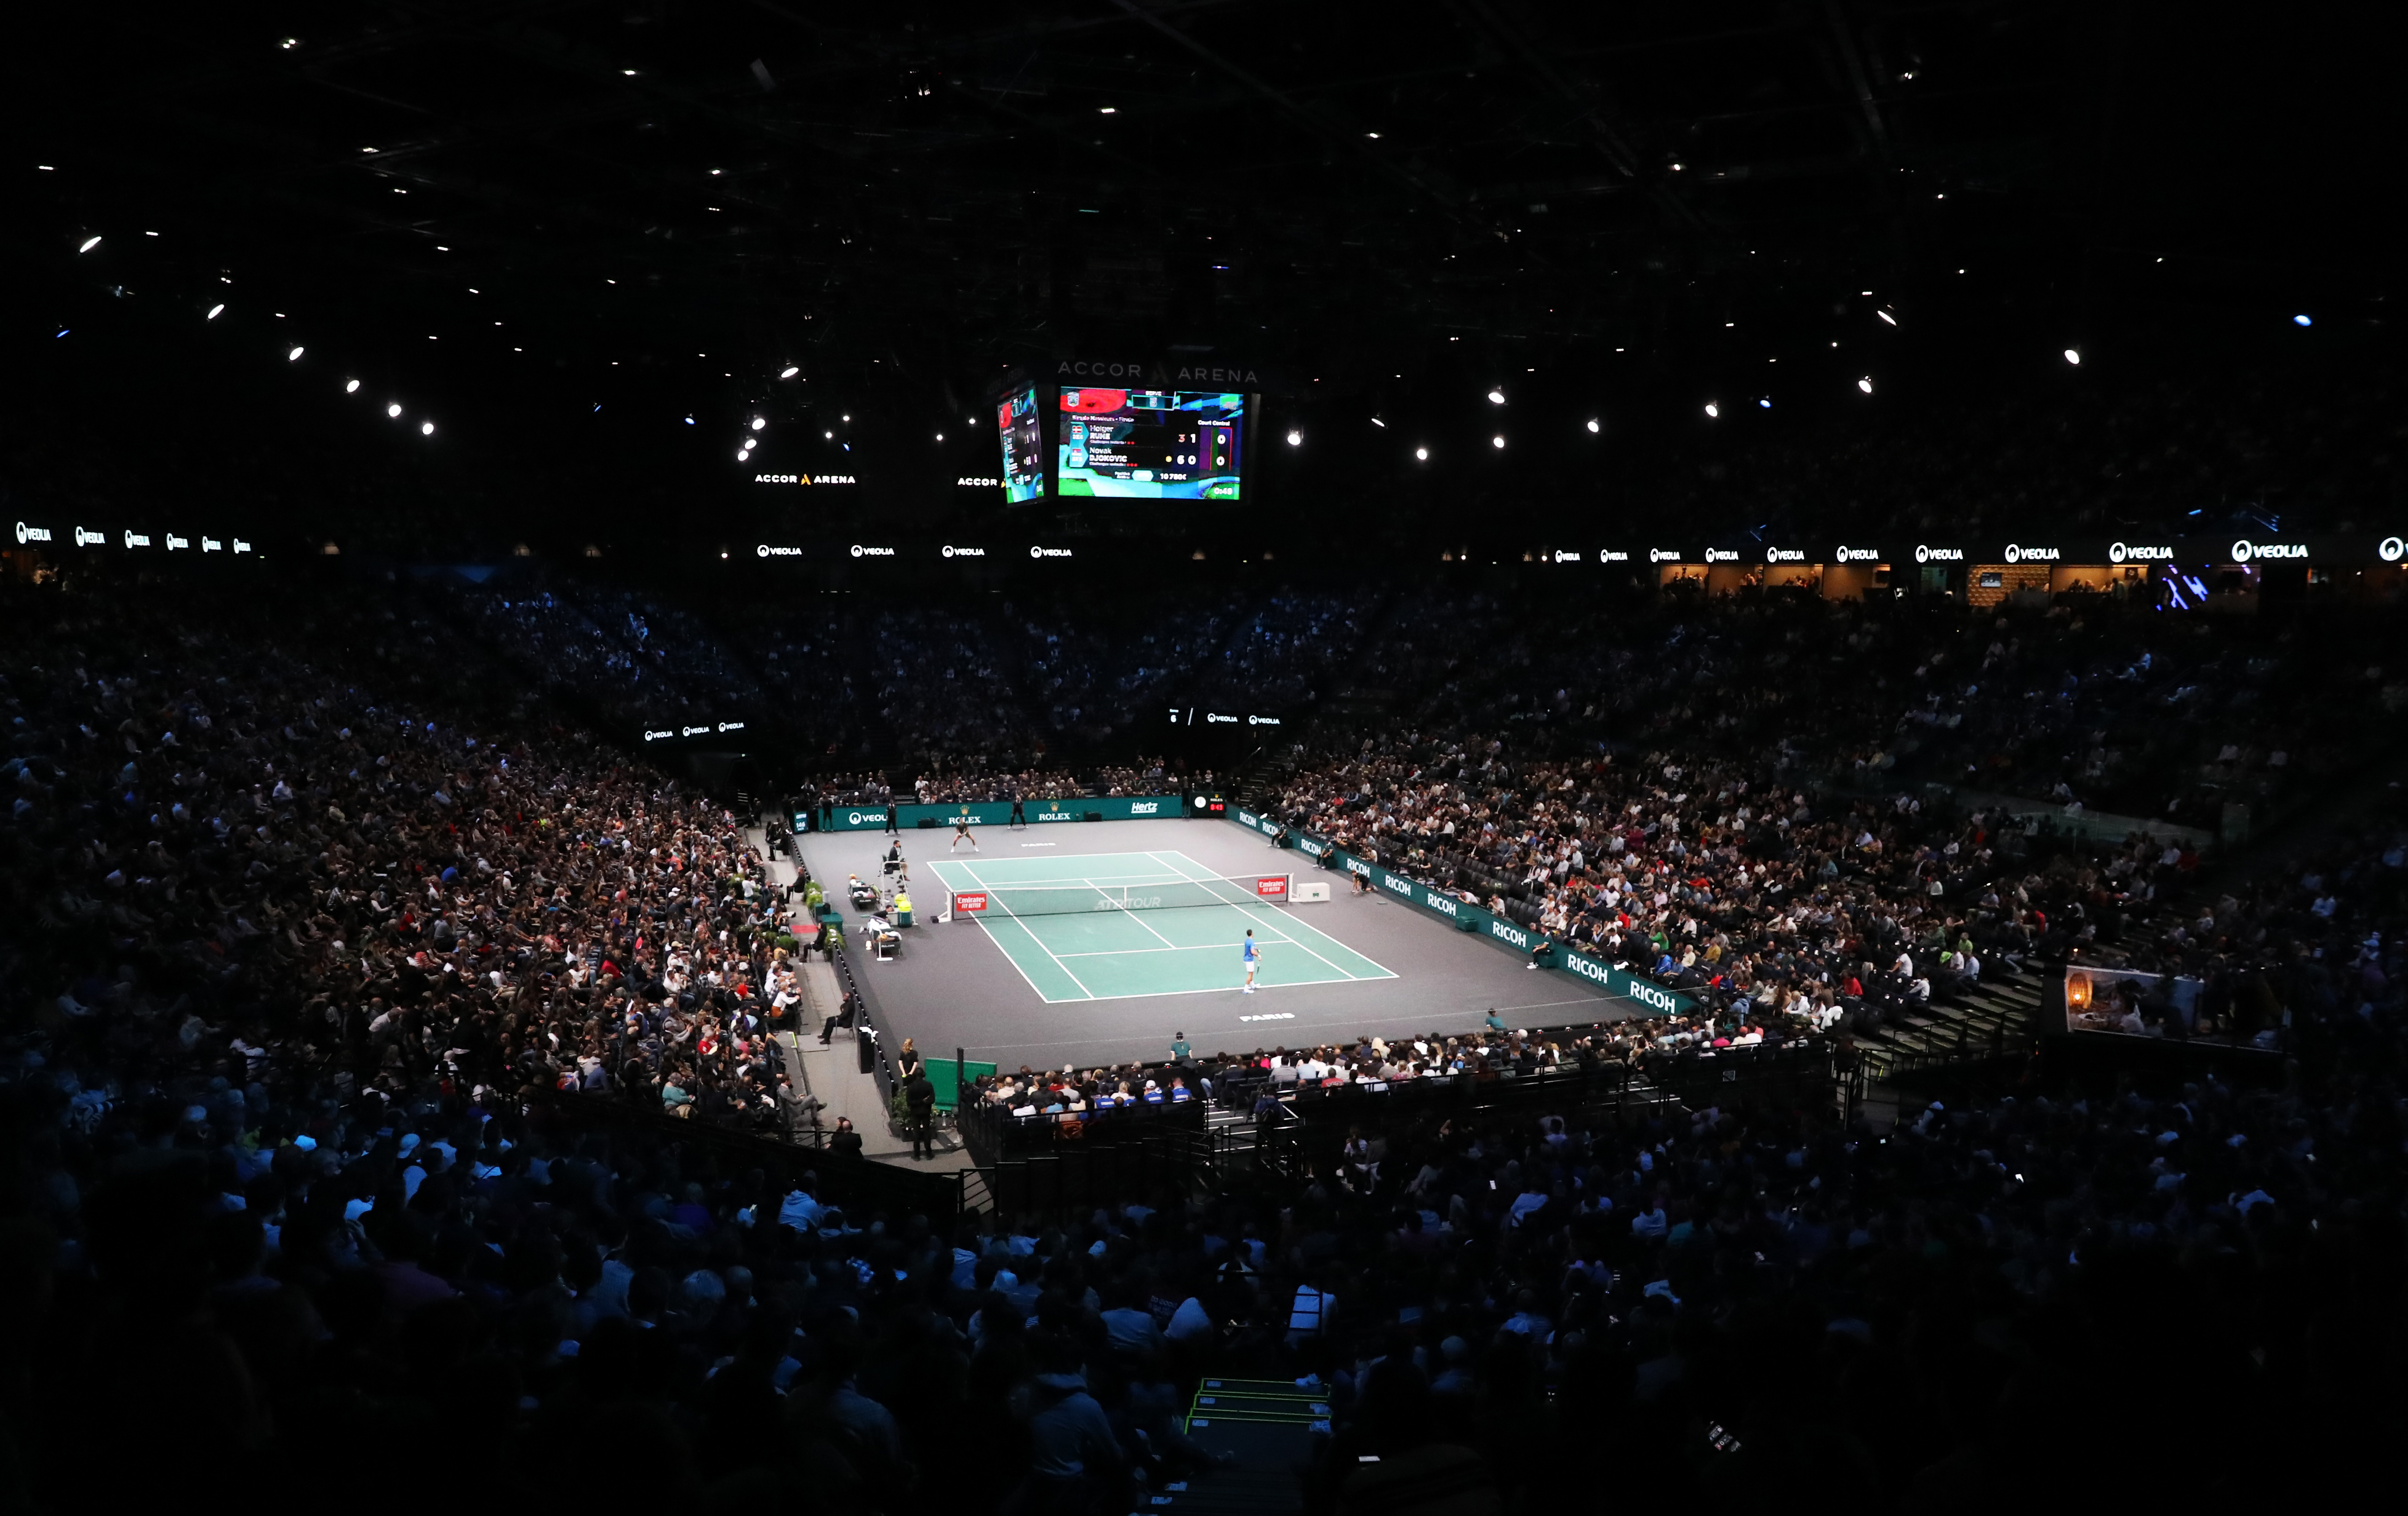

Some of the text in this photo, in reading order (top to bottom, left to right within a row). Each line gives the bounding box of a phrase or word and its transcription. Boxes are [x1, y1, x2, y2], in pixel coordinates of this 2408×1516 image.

[1058, 361, 1258, 383] ACCOR ARENA
[1190, 433, 1196, 443] 1
[1217, 434, 1226, 444] 0
[1177, 455, 1196, 465] 6 0
[1216, 456, 1225, 466] 0
[756, 474, 855, 483] ACCOR ARENA
[958, 477, 998, 486] ACCOR
[26, 528, 51, 541] VEOLIA
[84, 532, 105, 544] VEOLIA
[132, 535, 150, 546] VEOLIA
[174, 538, 188, 549] VEOLIA
[1562, 553, 1580, 561] VEOLIA
[1608, 552, 1628, 560] VEOLIA
[1659, 551, 1681, 560] VEOLIA
[1714, 551, 1739, 560] VEOLIA
[1778, 550, 1805, 560] VEOLIA
[1848, 549, 1879, 560] VEOLIA
[1929, 549, 1963, 560] VEOLIA
[2020, 548, 2060, 560] VEOLIA
[2127, 546, 2173, 559] VEOLIA
[2253, 545, 2309, 558] VEOLIA
[1131, 802, 1158, 811] Hertz
[1239, 812, 1256, 828] RICOH
[1301, 838, 1321, 855] RICOH
[1347, 857, 1370, 878] RICOH
[1385, 874, 1411, 896] RICOH
[1126, 897, 1161, 908] TOUR
[1428, 892, 1456, 916] RICOH
[1493, 921, 1527, 948] RICOH
[1567, 954, 1608, 984] RICOH
[1630, 981, 1675, 1014] RICOH
[1239, 1013, 1295, 1022] PARIS
